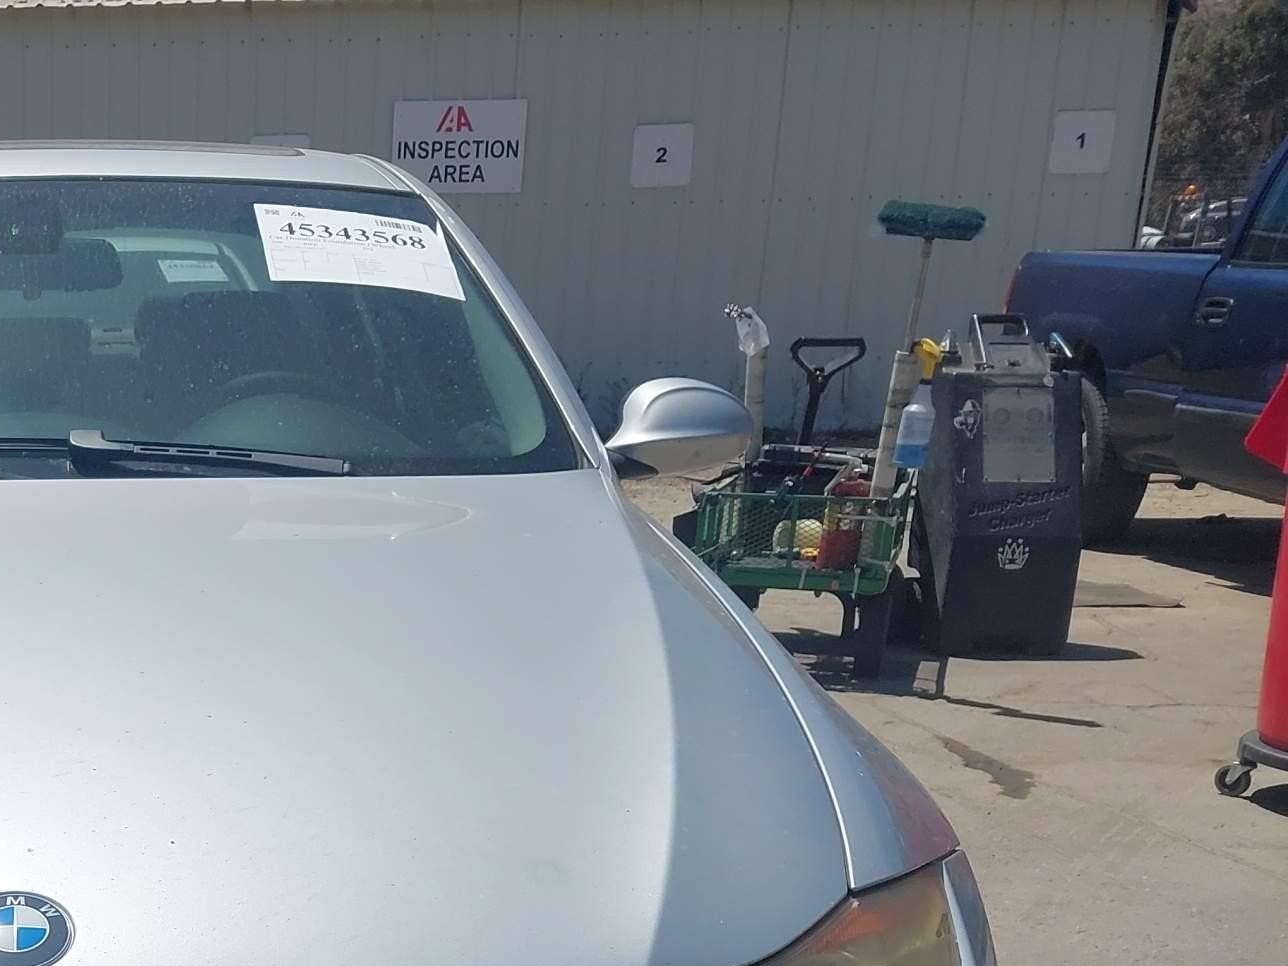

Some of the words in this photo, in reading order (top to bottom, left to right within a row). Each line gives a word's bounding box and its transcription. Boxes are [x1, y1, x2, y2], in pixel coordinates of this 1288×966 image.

[397, 139, 520, 160] INSPECTION
[1076, 132, 1086, 149] 1
[655, 146, 668, 163] 2
[429, 165, 485, 183] AREA
[279, 221, 426, 250] 45343568
[969, 486, 1073, 517] Jump-Starter
